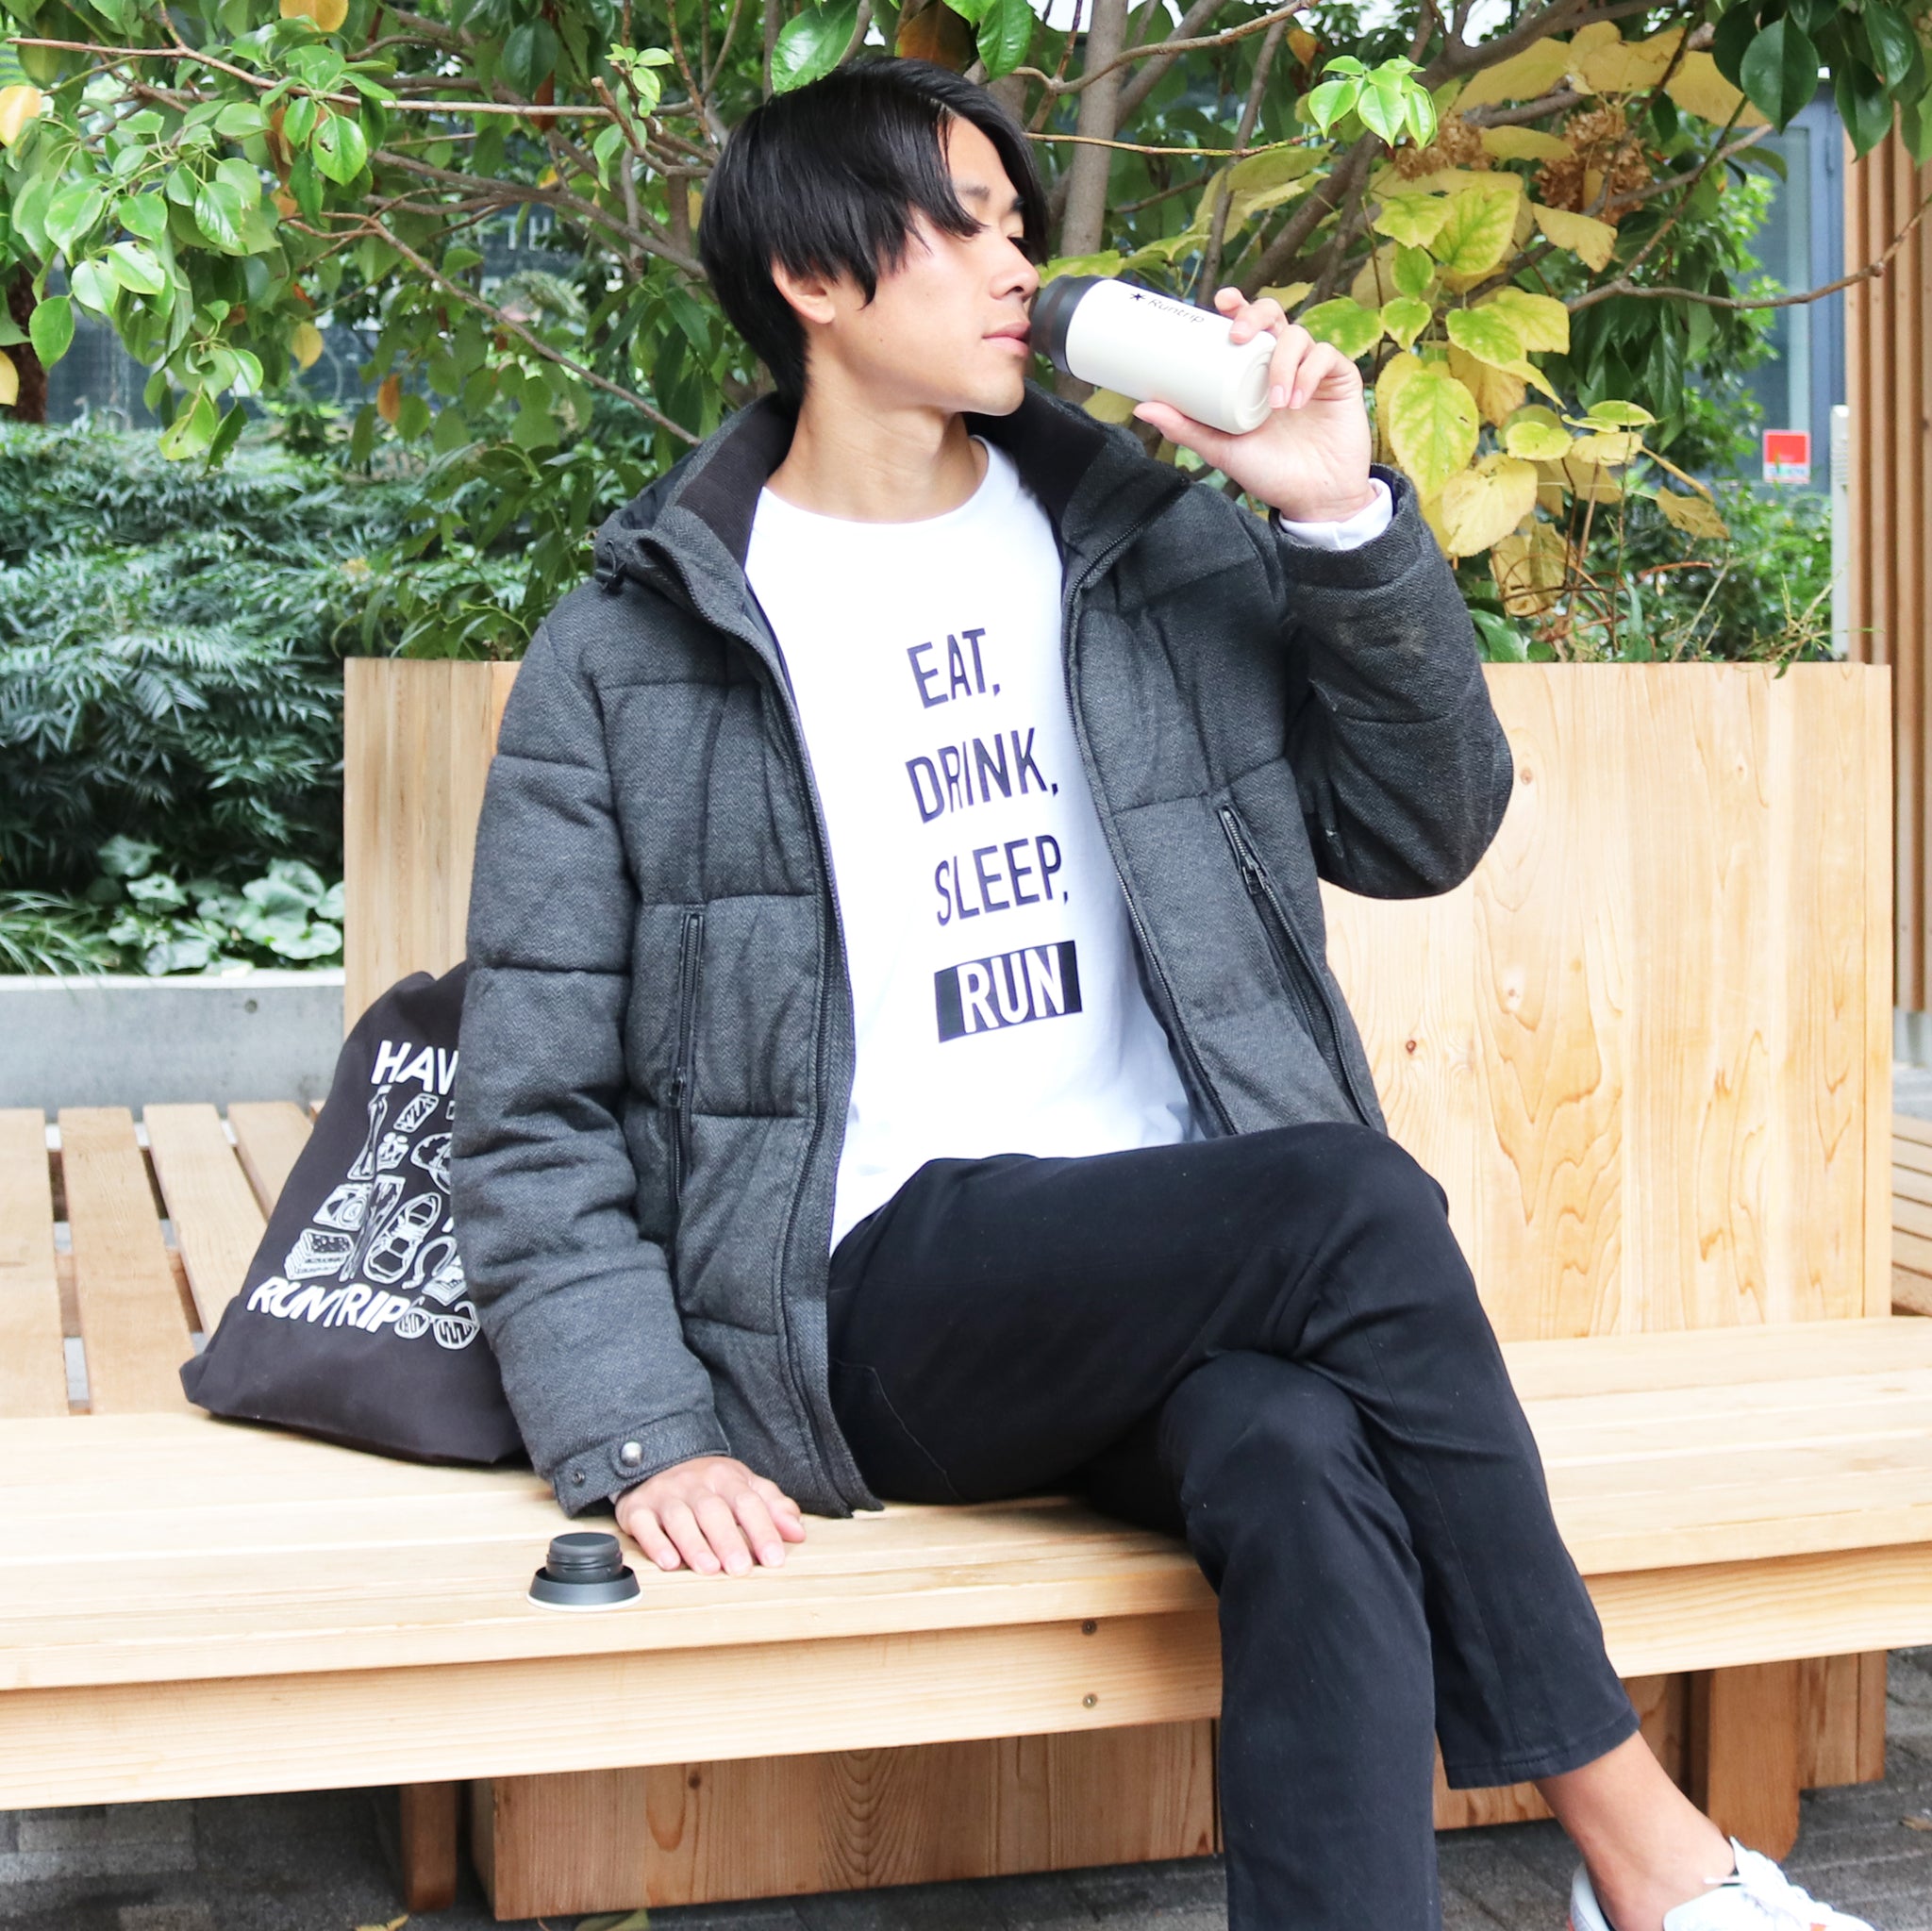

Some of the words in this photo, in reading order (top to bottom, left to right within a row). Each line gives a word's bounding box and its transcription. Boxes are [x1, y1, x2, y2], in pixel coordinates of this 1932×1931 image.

[1148, 298, 1205, 323] Runtrip
[907, 627, 1001, 708] EAT,
[905, 726, 1059, 824] DRINK,
[934, 834, 1069, 926] SLEEP,
[956, 945, 1066, 1034] RUN
